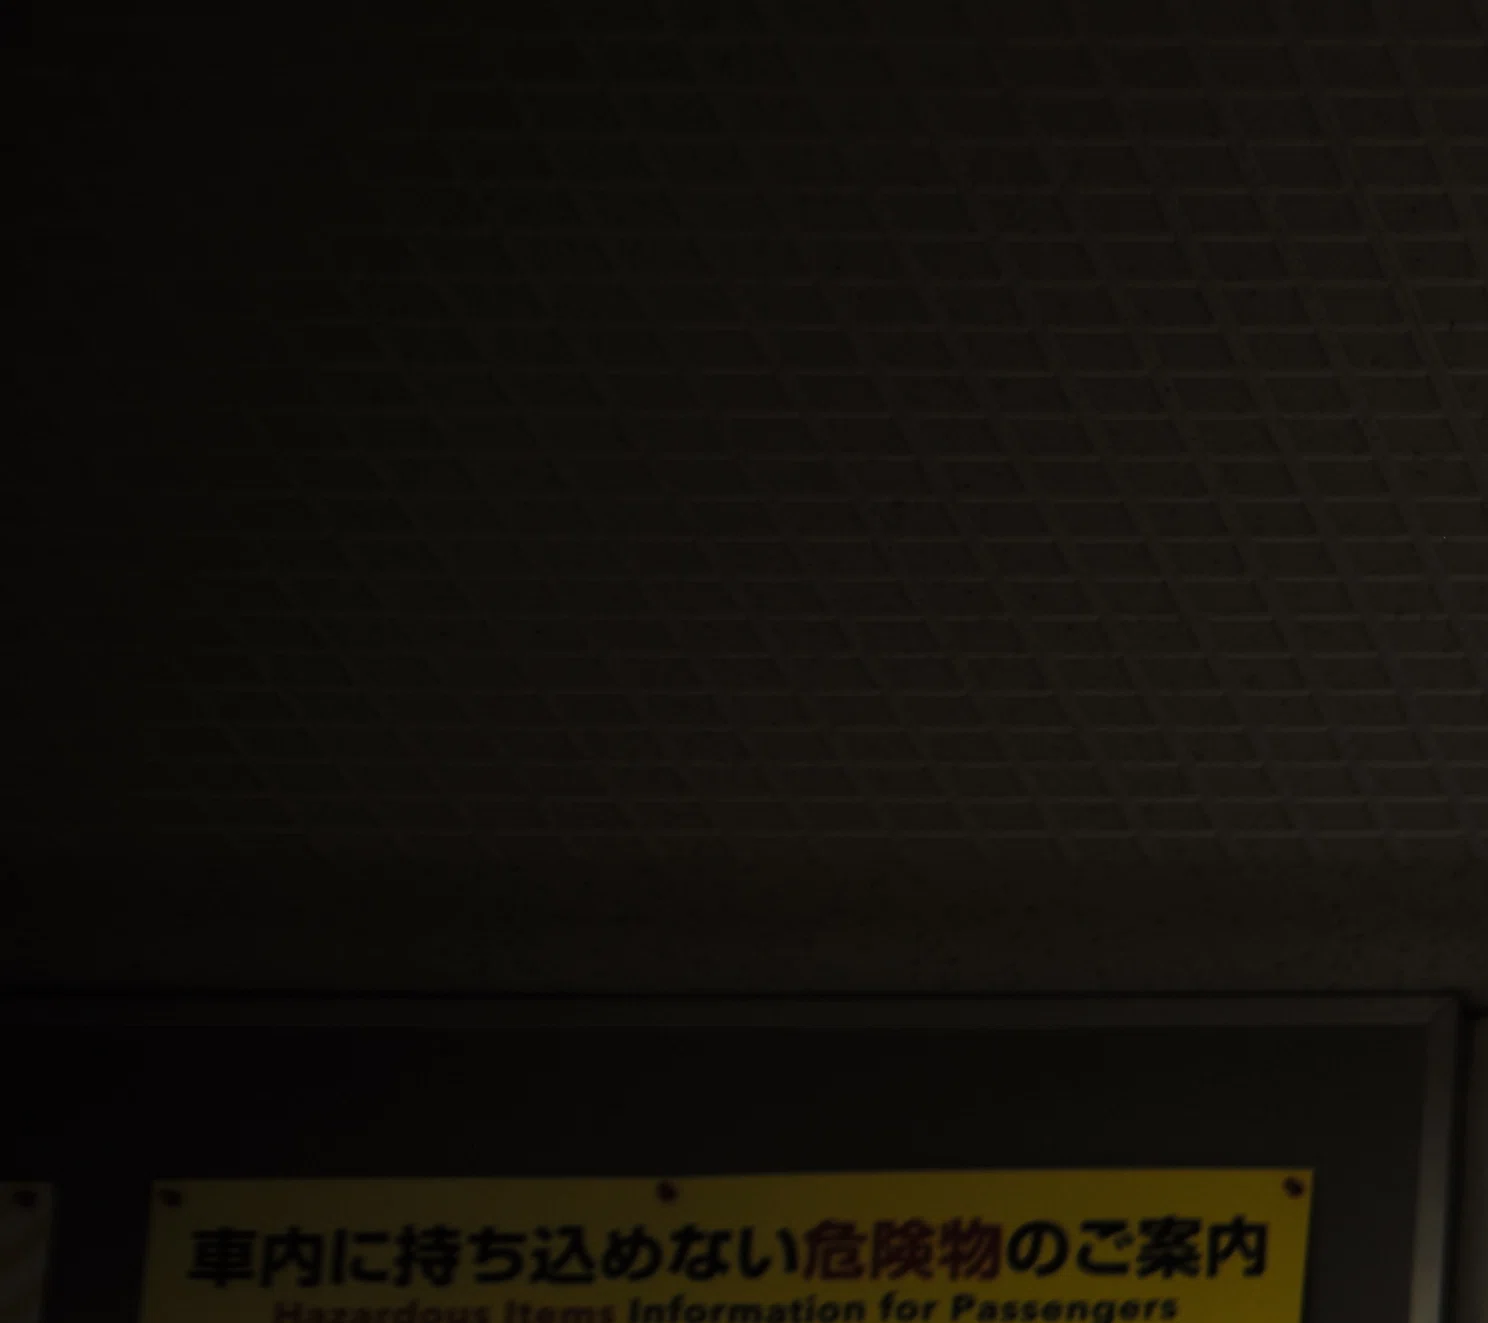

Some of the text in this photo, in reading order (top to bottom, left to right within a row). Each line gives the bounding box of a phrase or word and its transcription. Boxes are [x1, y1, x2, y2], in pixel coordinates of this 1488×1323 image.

[187, 1215, 1268, 1288] 車内に持ち込めない危険物のご案内
[880, 1294, 935, 1323] for
